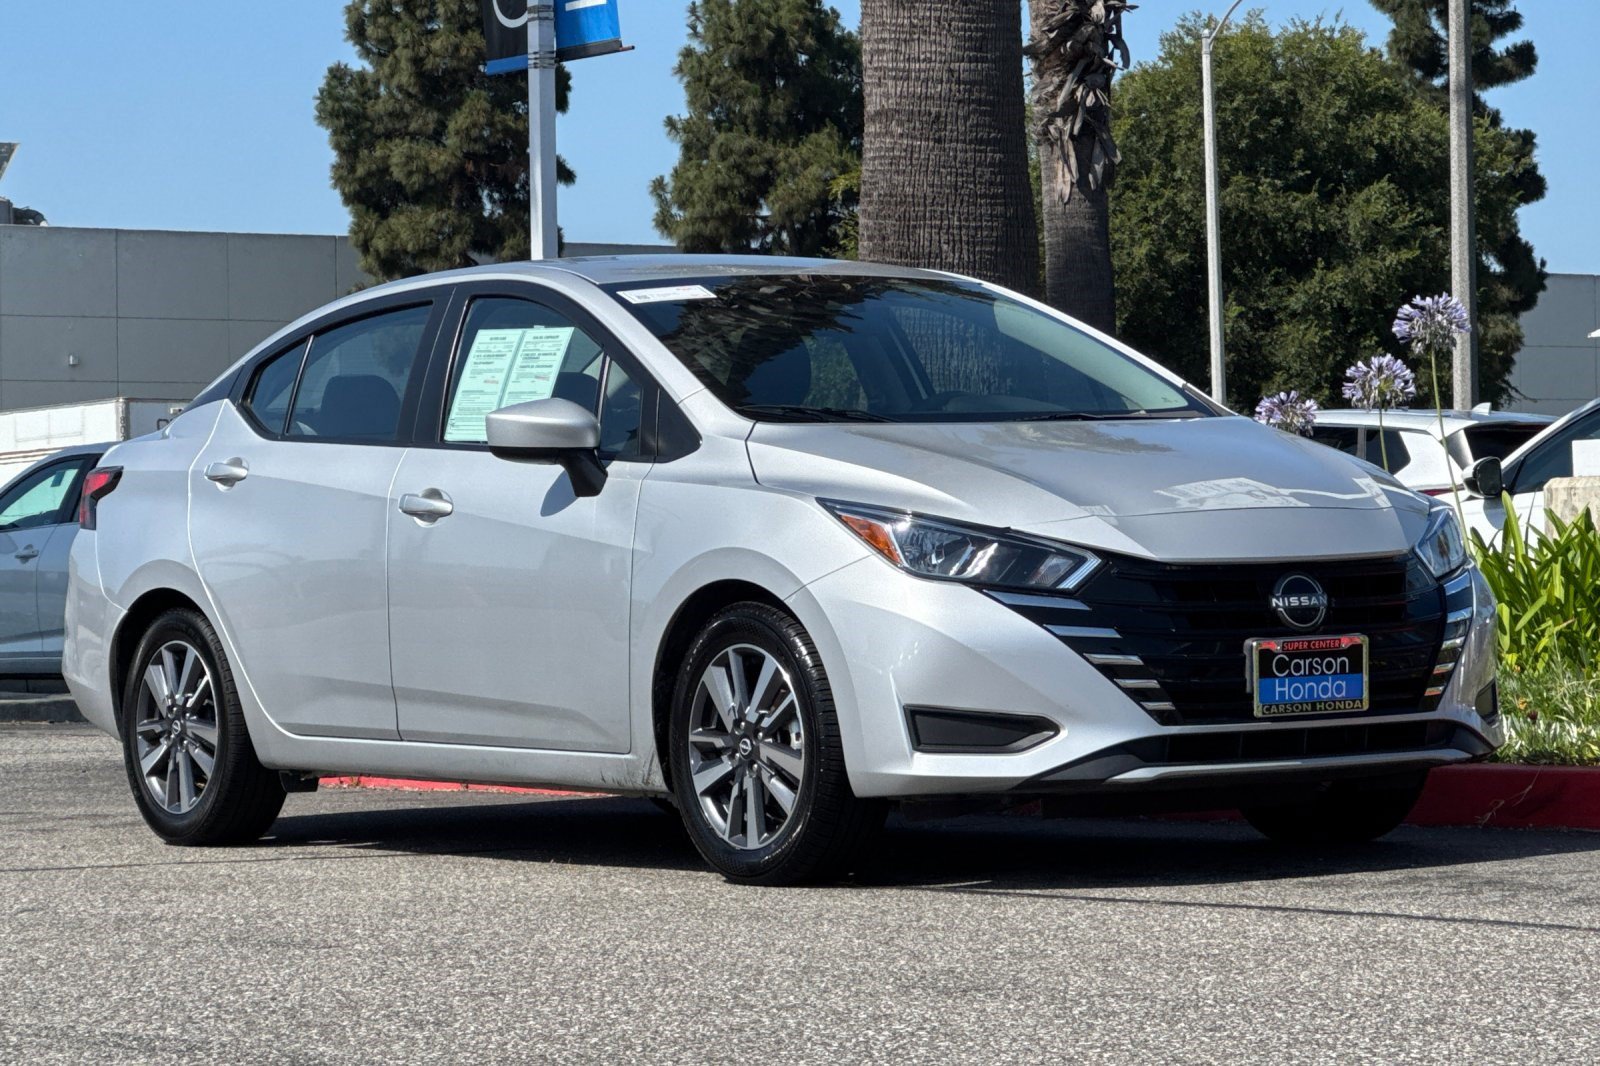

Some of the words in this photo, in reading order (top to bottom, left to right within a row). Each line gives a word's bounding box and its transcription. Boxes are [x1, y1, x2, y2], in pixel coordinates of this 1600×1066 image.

[1271, 595, 1328, 607] NISSAN
[1282, 641, 1308, 651] SUPER
[1310, 640, 1340, 649] CENTER
[1272, 654, 1349, 677] Carson
[1275, 677, 1346, 701] Honda
[1263, 703, 1312, 714] CARSON
[1316, 700, 1362, 710] HONDA
